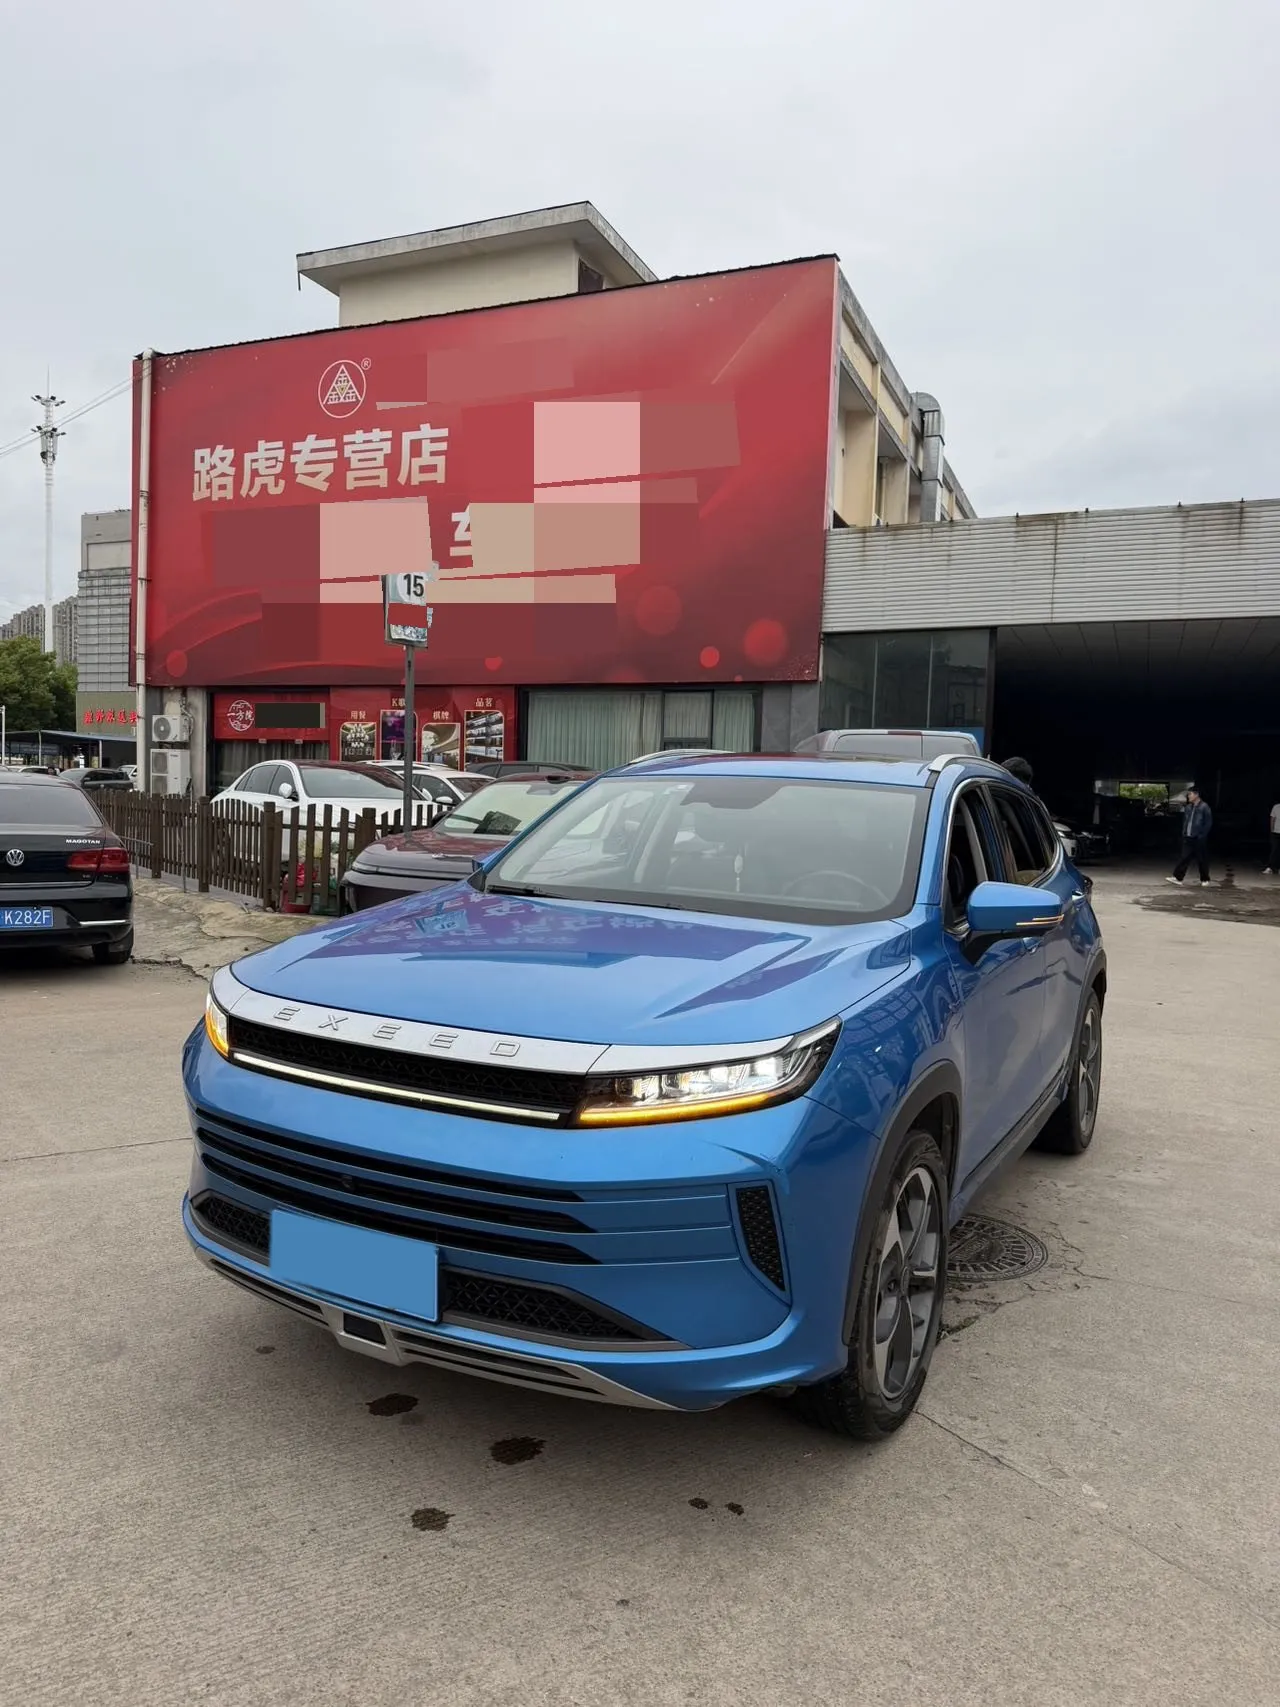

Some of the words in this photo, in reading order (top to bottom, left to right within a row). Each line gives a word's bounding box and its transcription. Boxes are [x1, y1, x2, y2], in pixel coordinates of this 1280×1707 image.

[193, 423, 449, 501] 路虎专营店
[273, 1005, 521, 1058] EXEED
